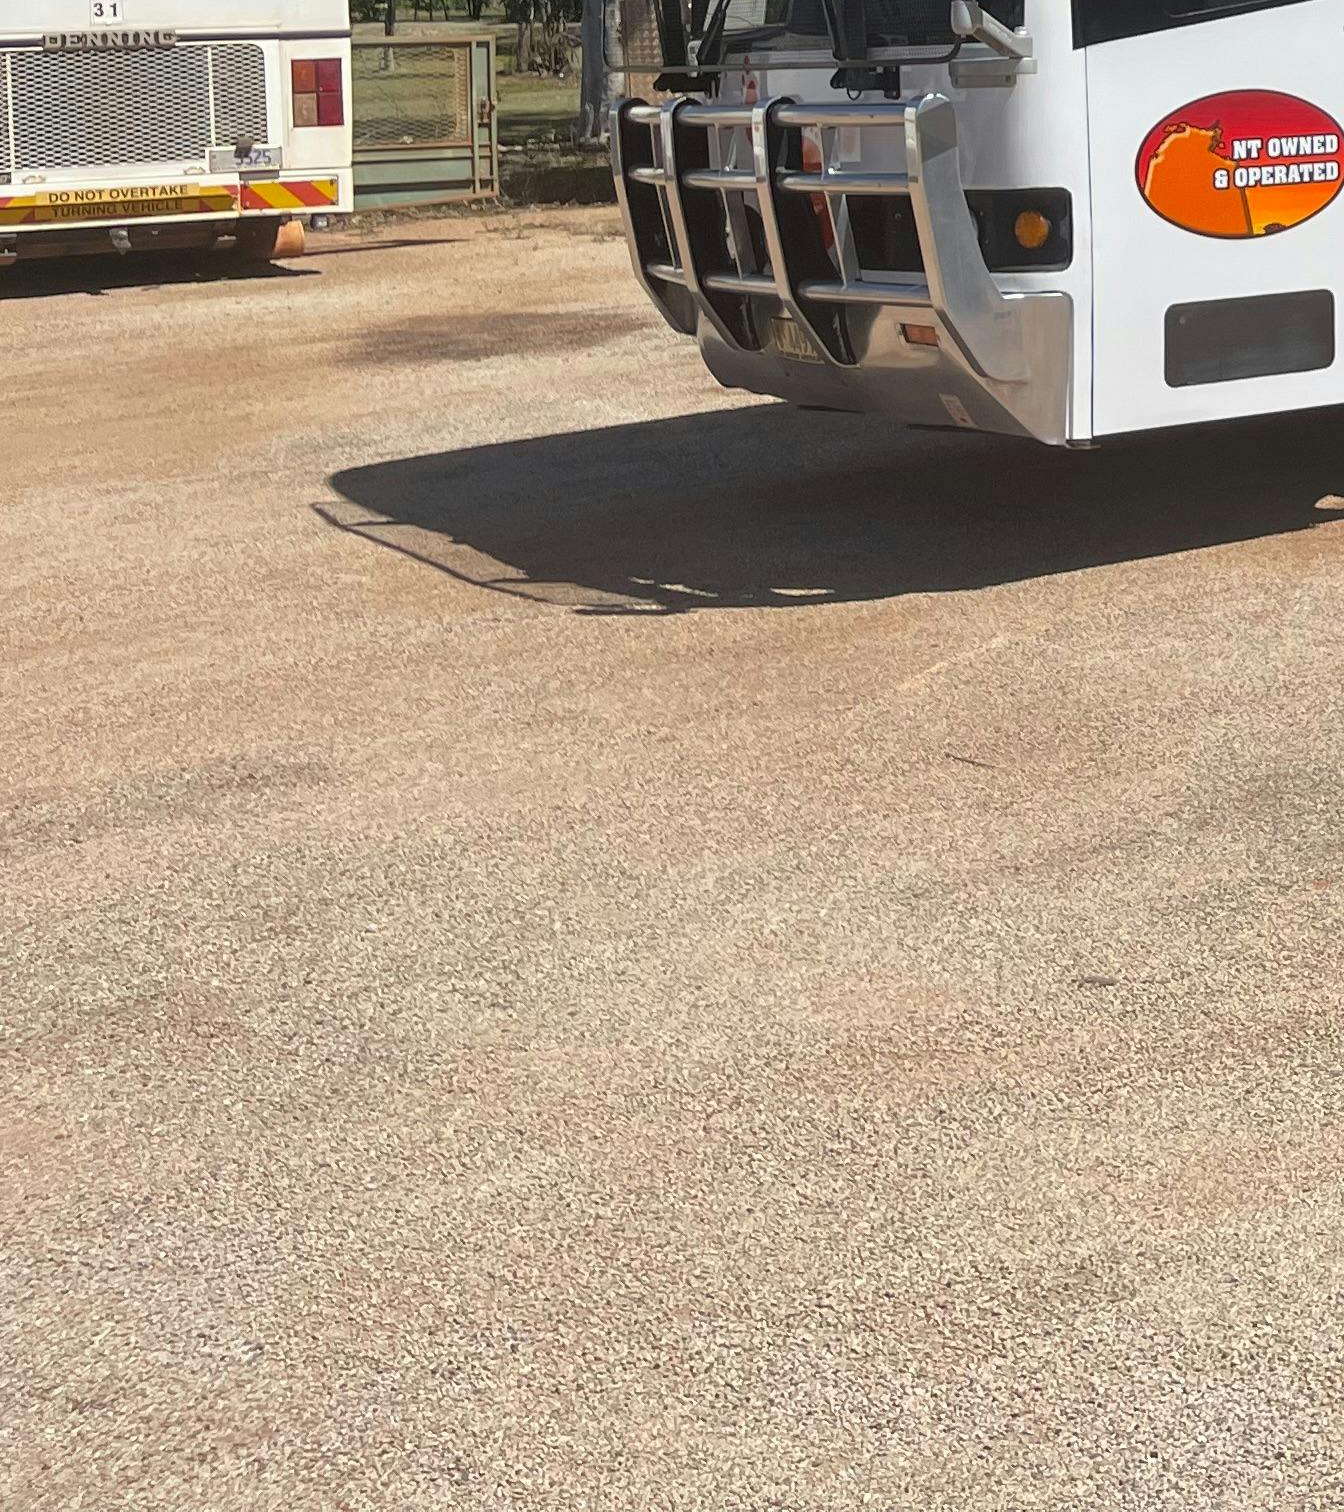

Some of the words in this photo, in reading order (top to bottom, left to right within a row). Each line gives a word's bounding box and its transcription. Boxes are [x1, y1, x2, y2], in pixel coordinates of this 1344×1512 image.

[93, 2, 118, 18] 31
[43, 29, 176, 49] DENNING
[1232, 139, 1262, 159] NT
[1267, 134, 1339, 157] OWNED
[1214, 169, 1228, 188] &
[1234, 161, 1339, 187] OPERATED
[49, 192, 70, 204] DO
[75, 189, 104, 202] NOT
[109, 184, 188, 199] OVERTAKE
[52, 203, 117, 218] TURNING
[122, 199, 183, 214] VEHICLE
